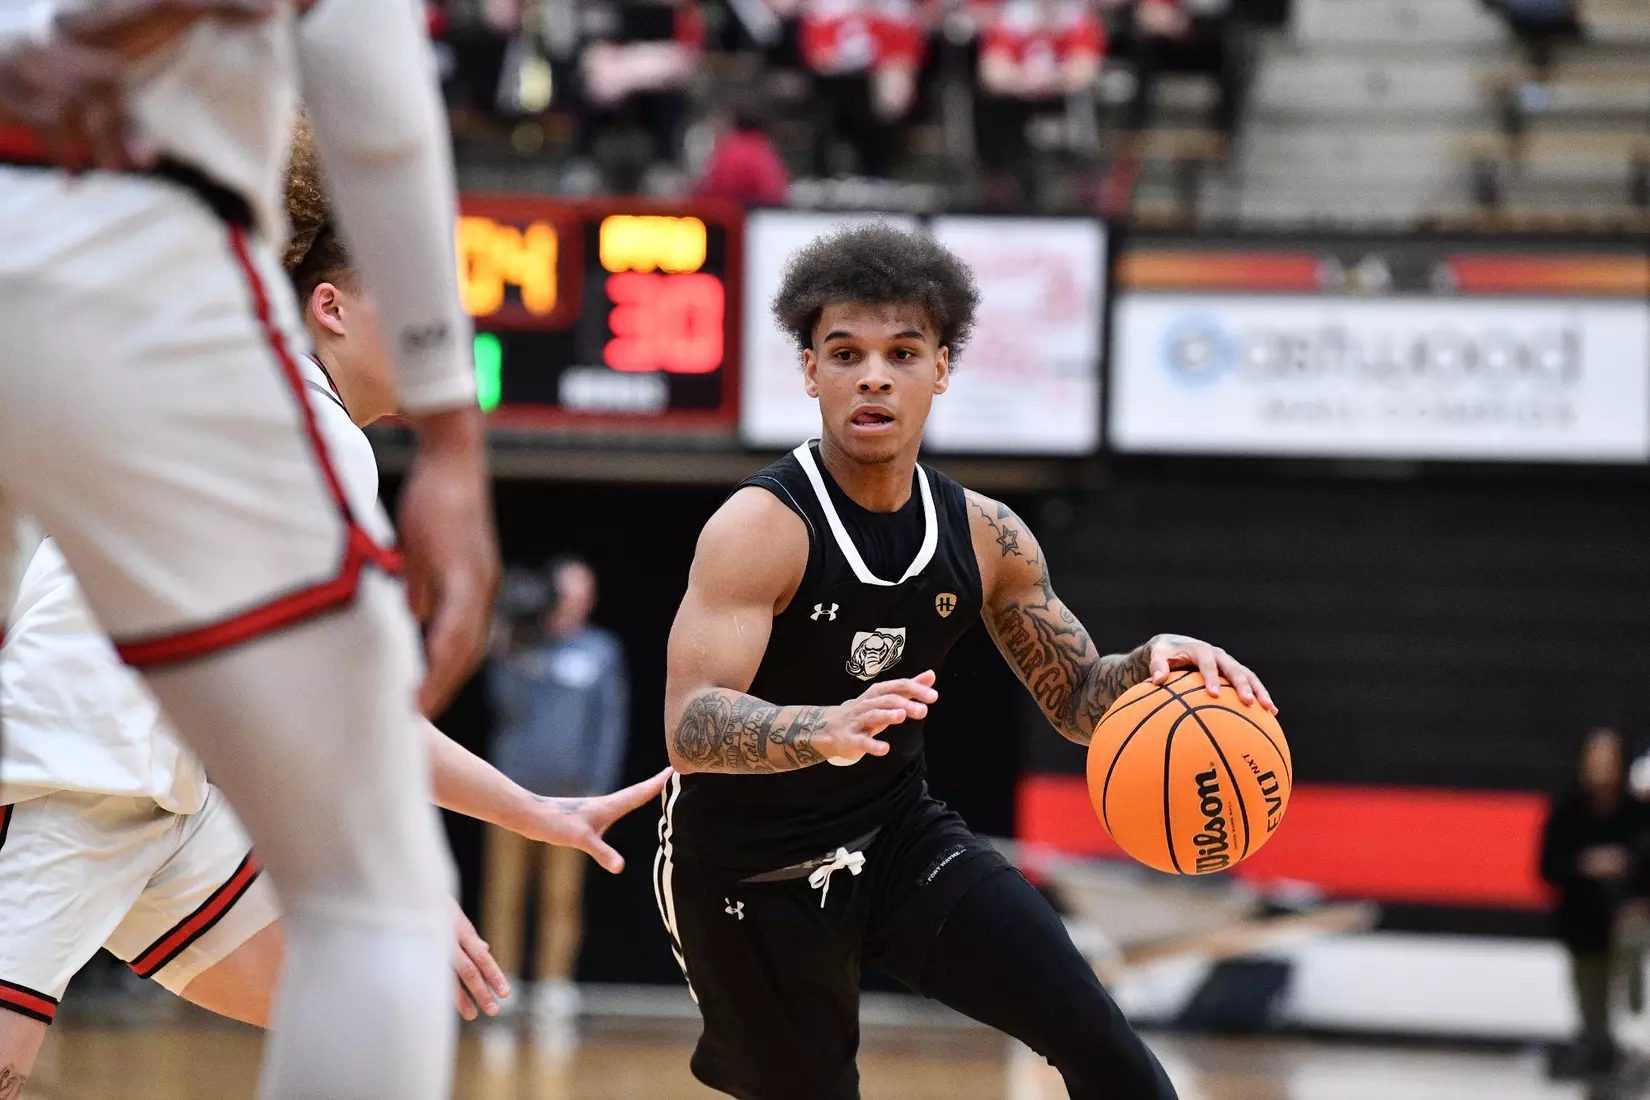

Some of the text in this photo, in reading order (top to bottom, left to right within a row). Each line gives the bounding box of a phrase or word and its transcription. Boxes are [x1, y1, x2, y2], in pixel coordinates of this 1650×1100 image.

[604, 272, 725, 373] 30
[1000, 610, 1043, 681] FEAR
[1242, 752, 1261, 775] NXT
[1192, 768, 1230, 873] Wilson
[927, 851, 961, 882] FORT WAYNE
